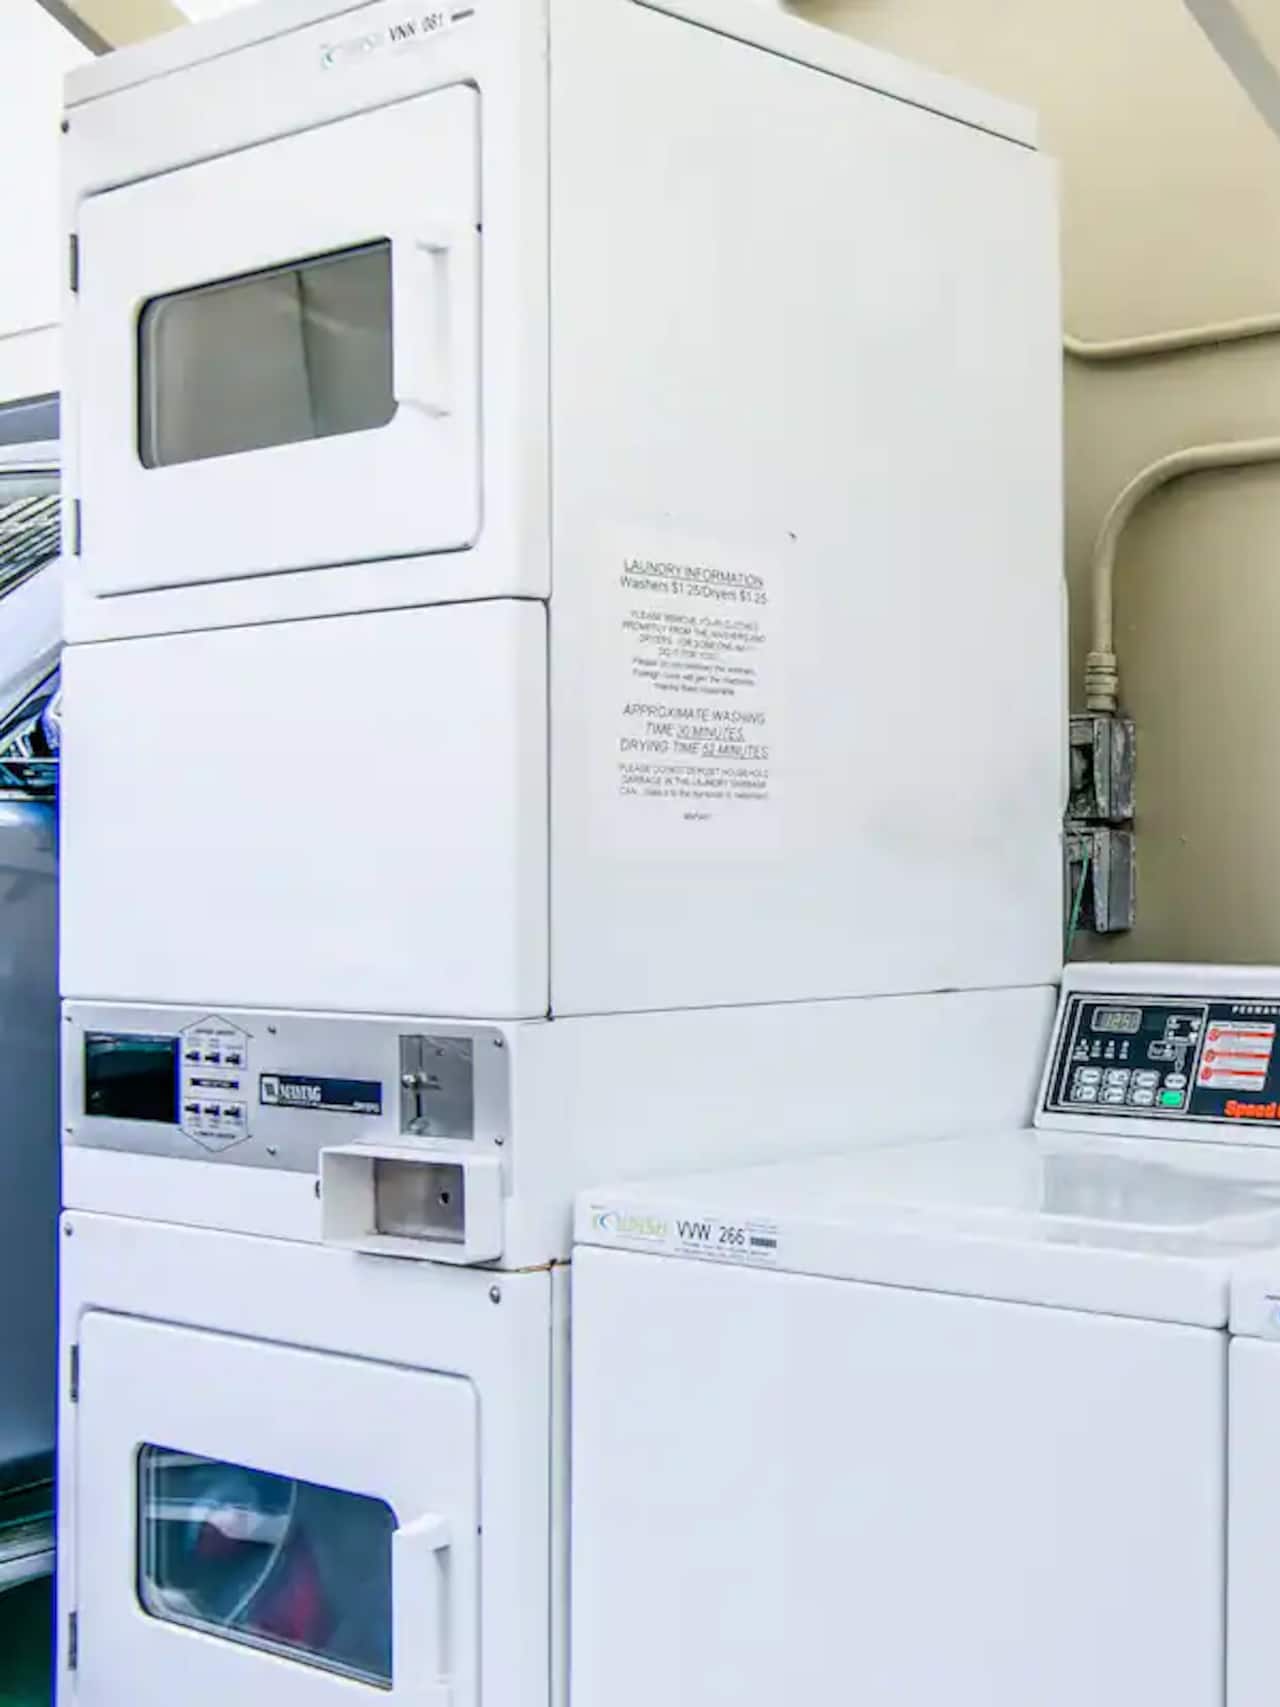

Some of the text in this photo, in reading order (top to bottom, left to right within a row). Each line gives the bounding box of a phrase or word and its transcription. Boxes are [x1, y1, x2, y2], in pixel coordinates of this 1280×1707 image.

[623, 558, 764, 588] LAUNDRY INFORMATION
[620, 575, 669, 593] Washers
[622, 702, 767, 727] APPROXIMATE WASHING
[646, 721, 675, 738] TIME
[619, 737, 670, 755] DRYING
[673, 740, 701, 755] TIME
[1224, 1100, 1275, 1120] Speed
[718, 1225, 746, 1246] 266
